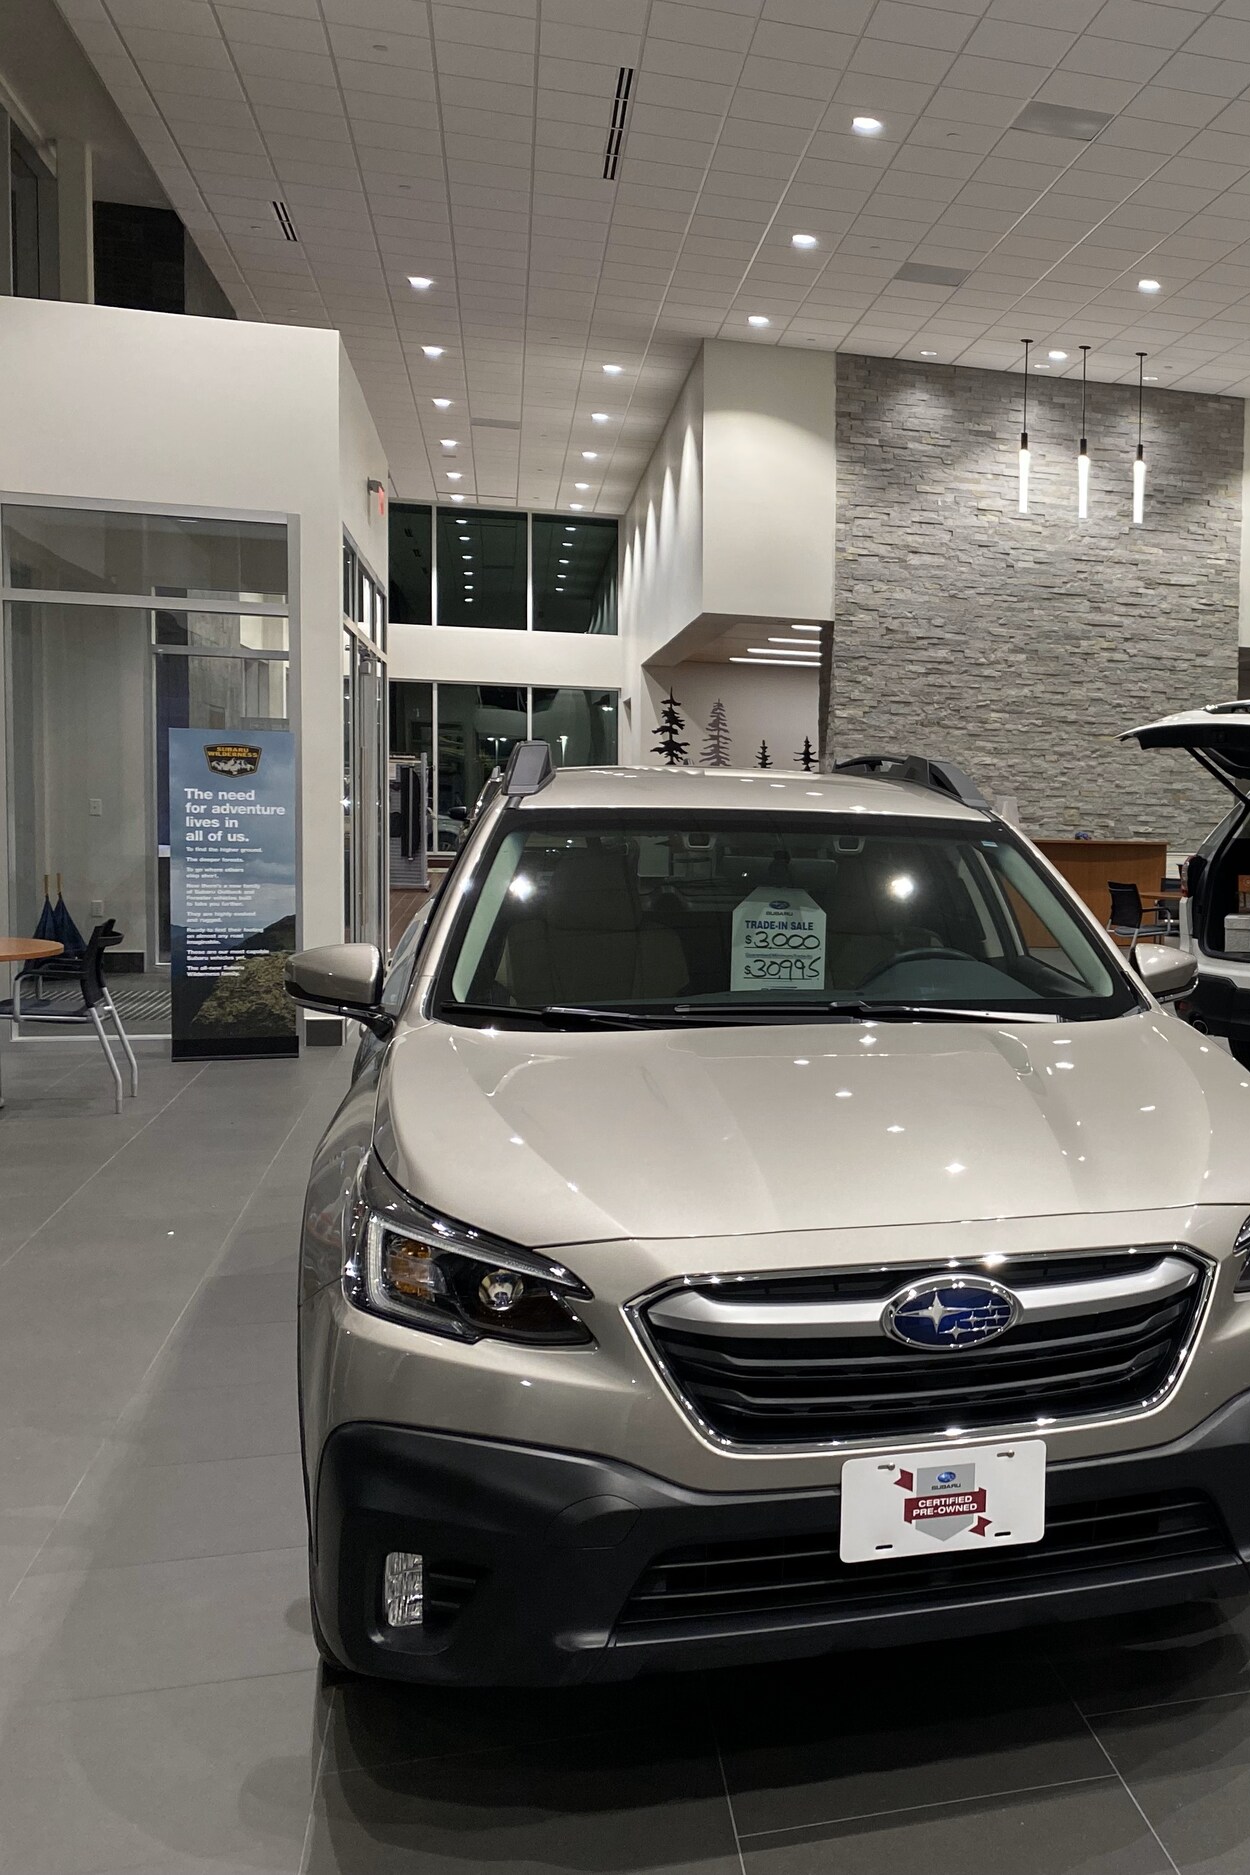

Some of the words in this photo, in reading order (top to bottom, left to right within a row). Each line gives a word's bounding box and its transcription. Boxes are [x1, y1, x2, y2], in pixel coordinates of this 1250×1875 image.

[184, 788, 213, 800] The
[218, 790, 255, 800] need
[185, 802, 207, 813] for
[211, 803, 286, 815] adventure
[185, 816, 220, 827] lives
[224, 817, 238, 828] in
[185, 830, 203, 841] all
[207, 831, 223, 842] of
[227, 833, 250, 842] us.
[745, 920, 788, 930] TRADE-IN
[790, 921, 814, 931] SALE
[931, 1483, 961, 1491] SUBARU
[918, 1495, 973, 1508] CERTIFIED
[913, 1503, 977, 1517] PRE-OWNED
